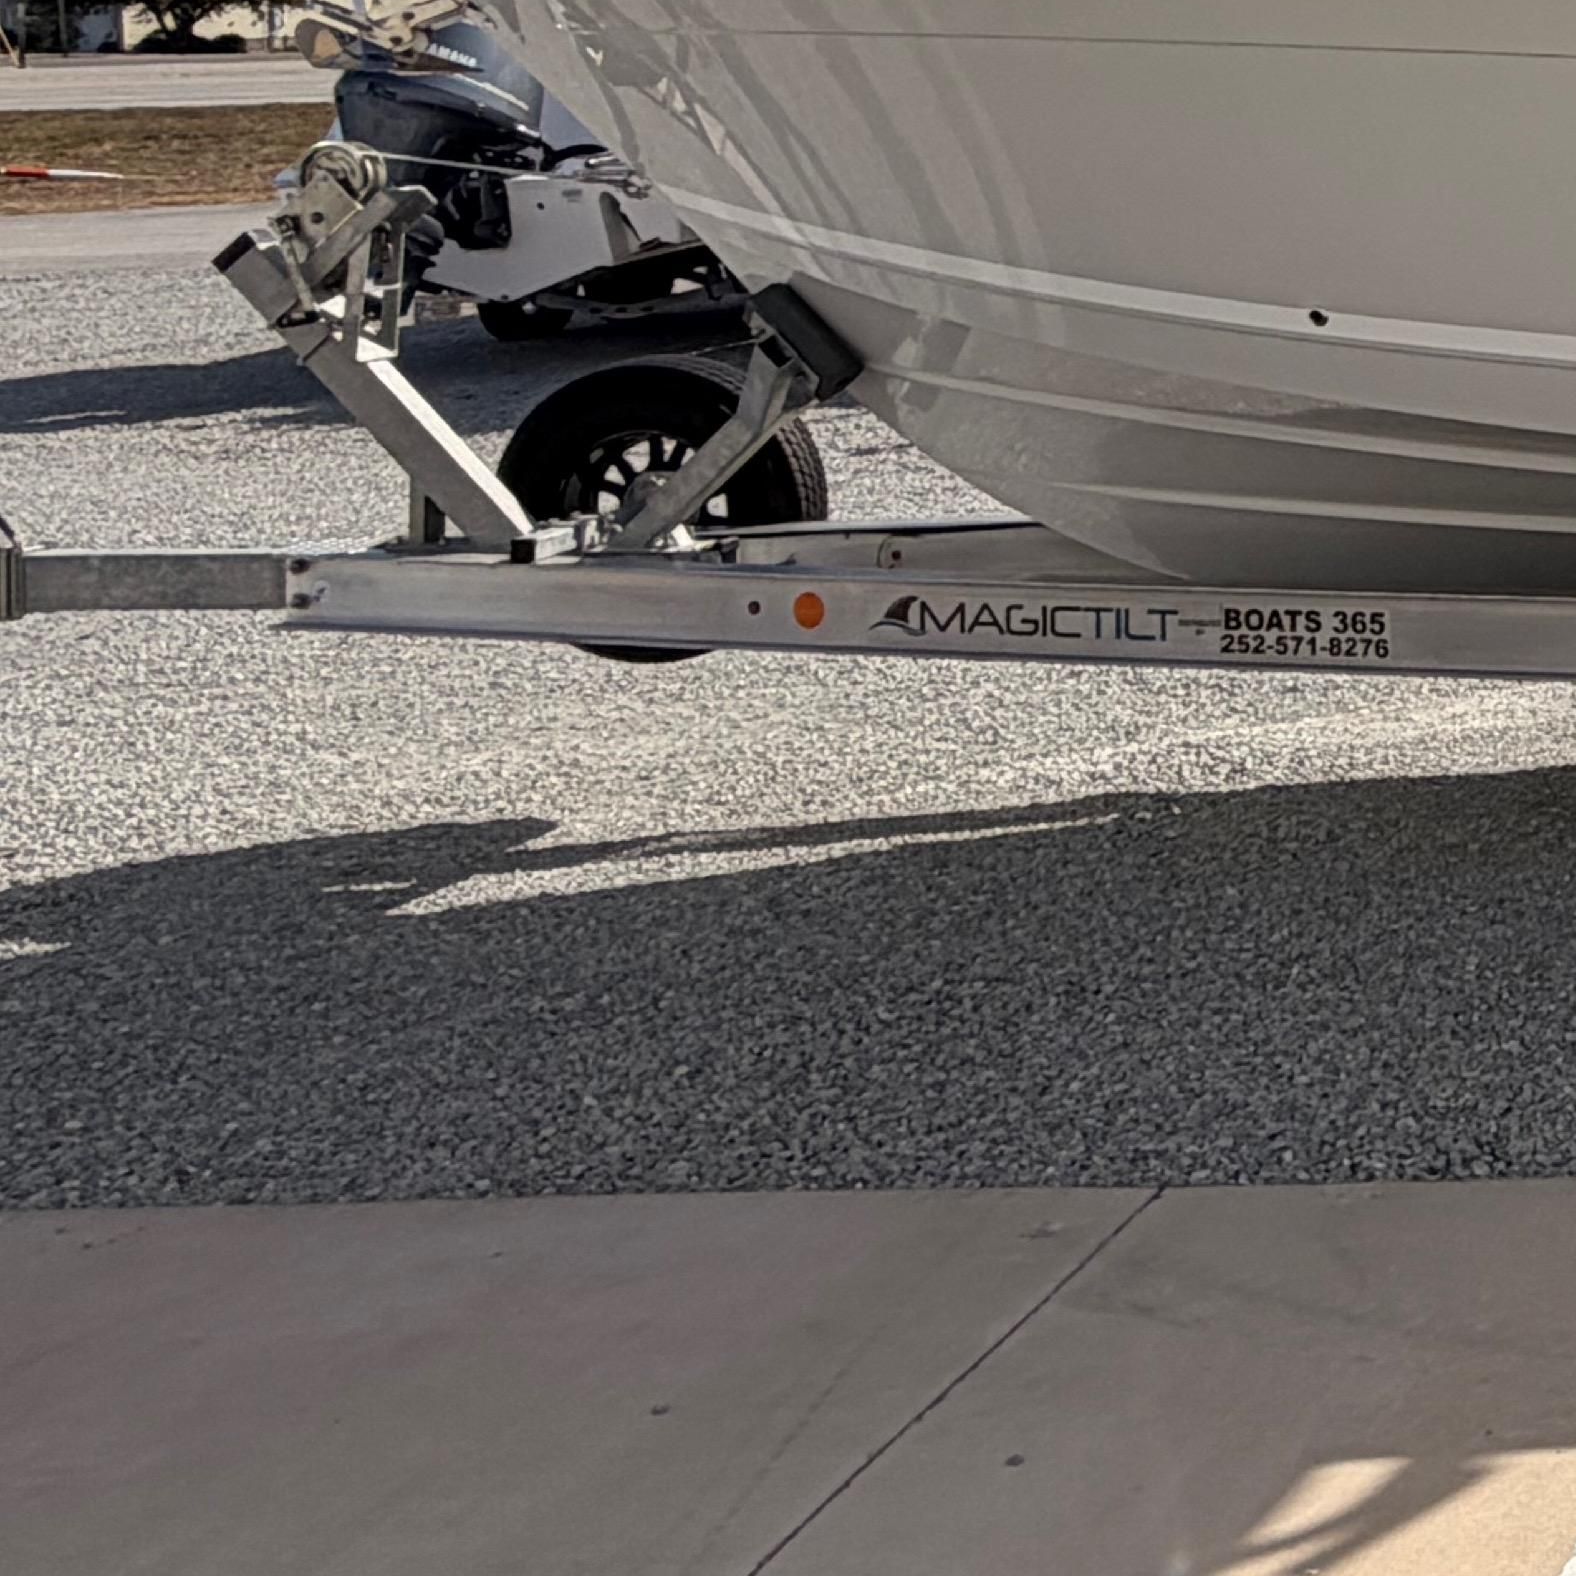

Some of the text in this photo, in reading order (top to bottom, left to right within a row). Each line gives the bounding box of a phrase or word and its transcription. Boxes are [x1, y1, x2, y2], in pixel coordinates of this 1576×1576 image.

[425, 43, 478, 68] AMAHA
[919, 600, 1180, 642] MAGICTILT
[1223, 608, 1322, 633] BOATS
[1331, 610, 1386, 636] 365
[1220, 633, 1390, 659] 252-571-8276
